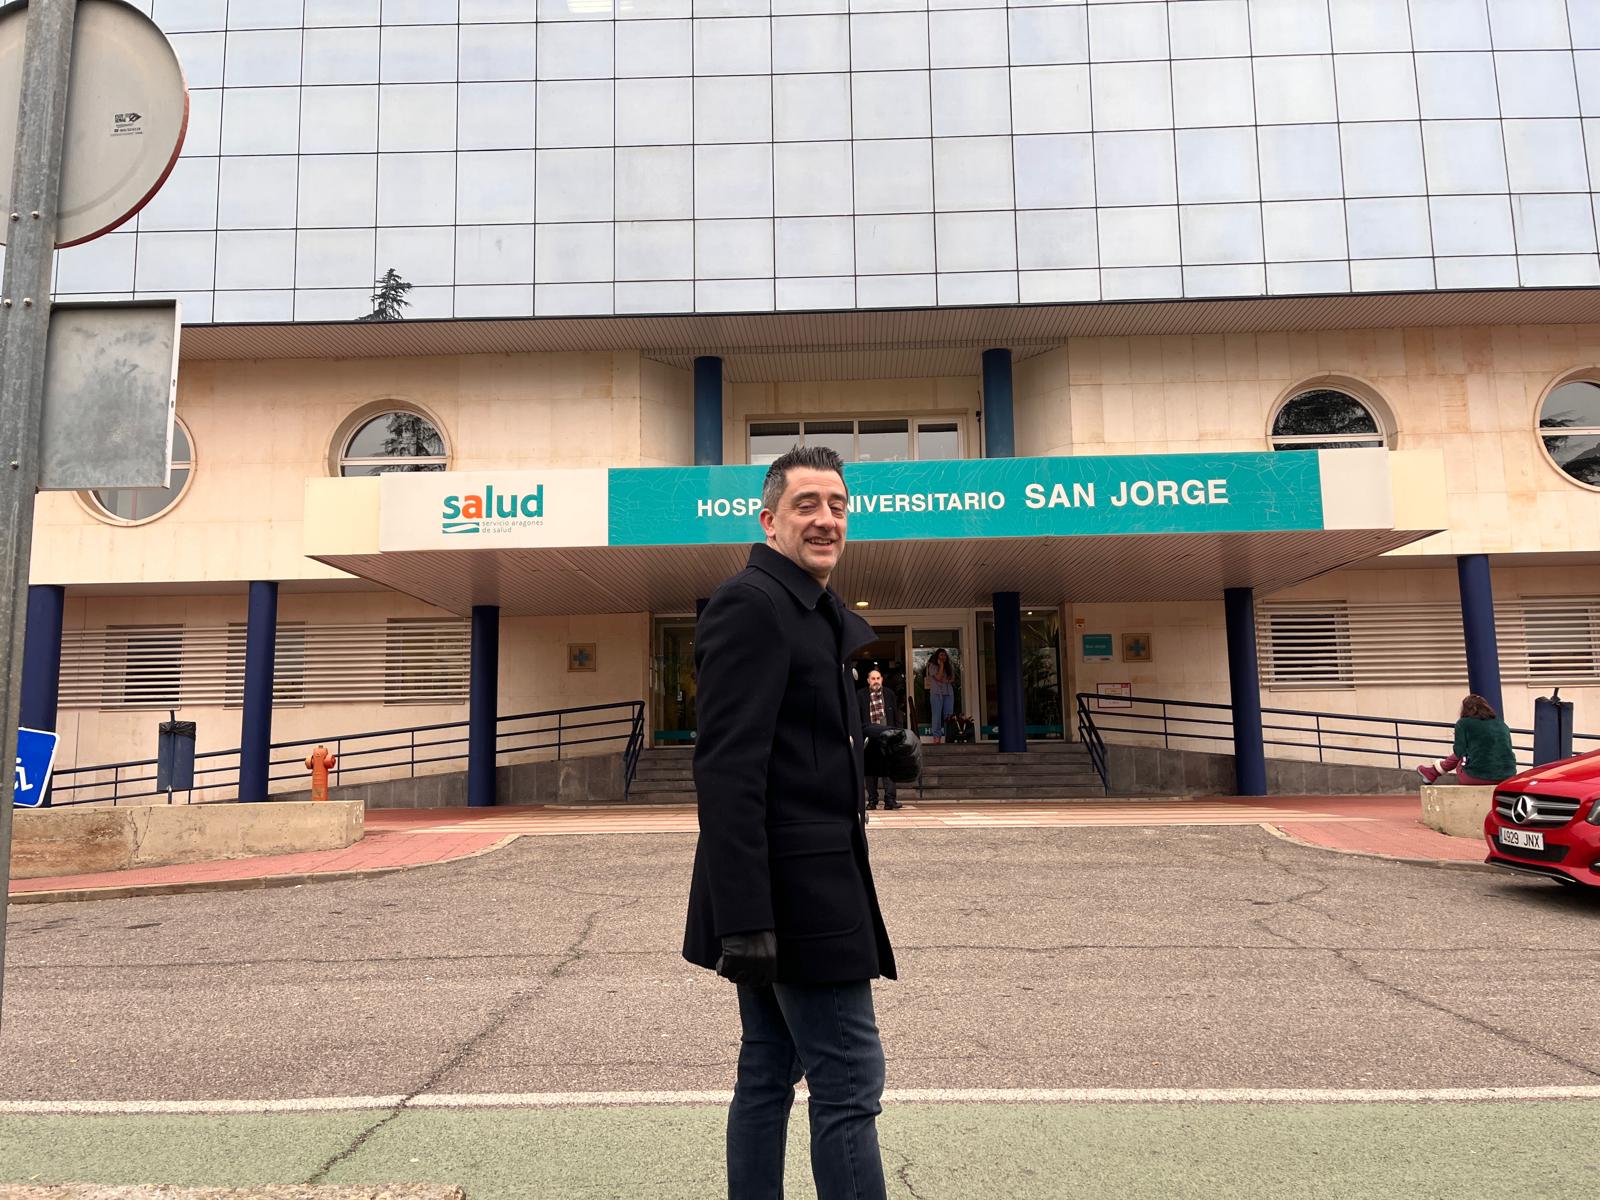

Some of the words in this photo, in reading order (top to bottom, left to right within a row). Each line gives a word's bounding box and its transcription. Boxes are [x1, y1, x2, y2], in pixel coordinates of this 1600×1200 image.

[442, 484, 544, 519] salud
[697, 498, 763, 517] HOSP
[847, 491, 1006, 513] NIVERSITARIO
[1024, 482, 1096, 509] SAN
[1110, 479, 1229, 507] JORGE
[1523, 834, 1540, 848] JNX
